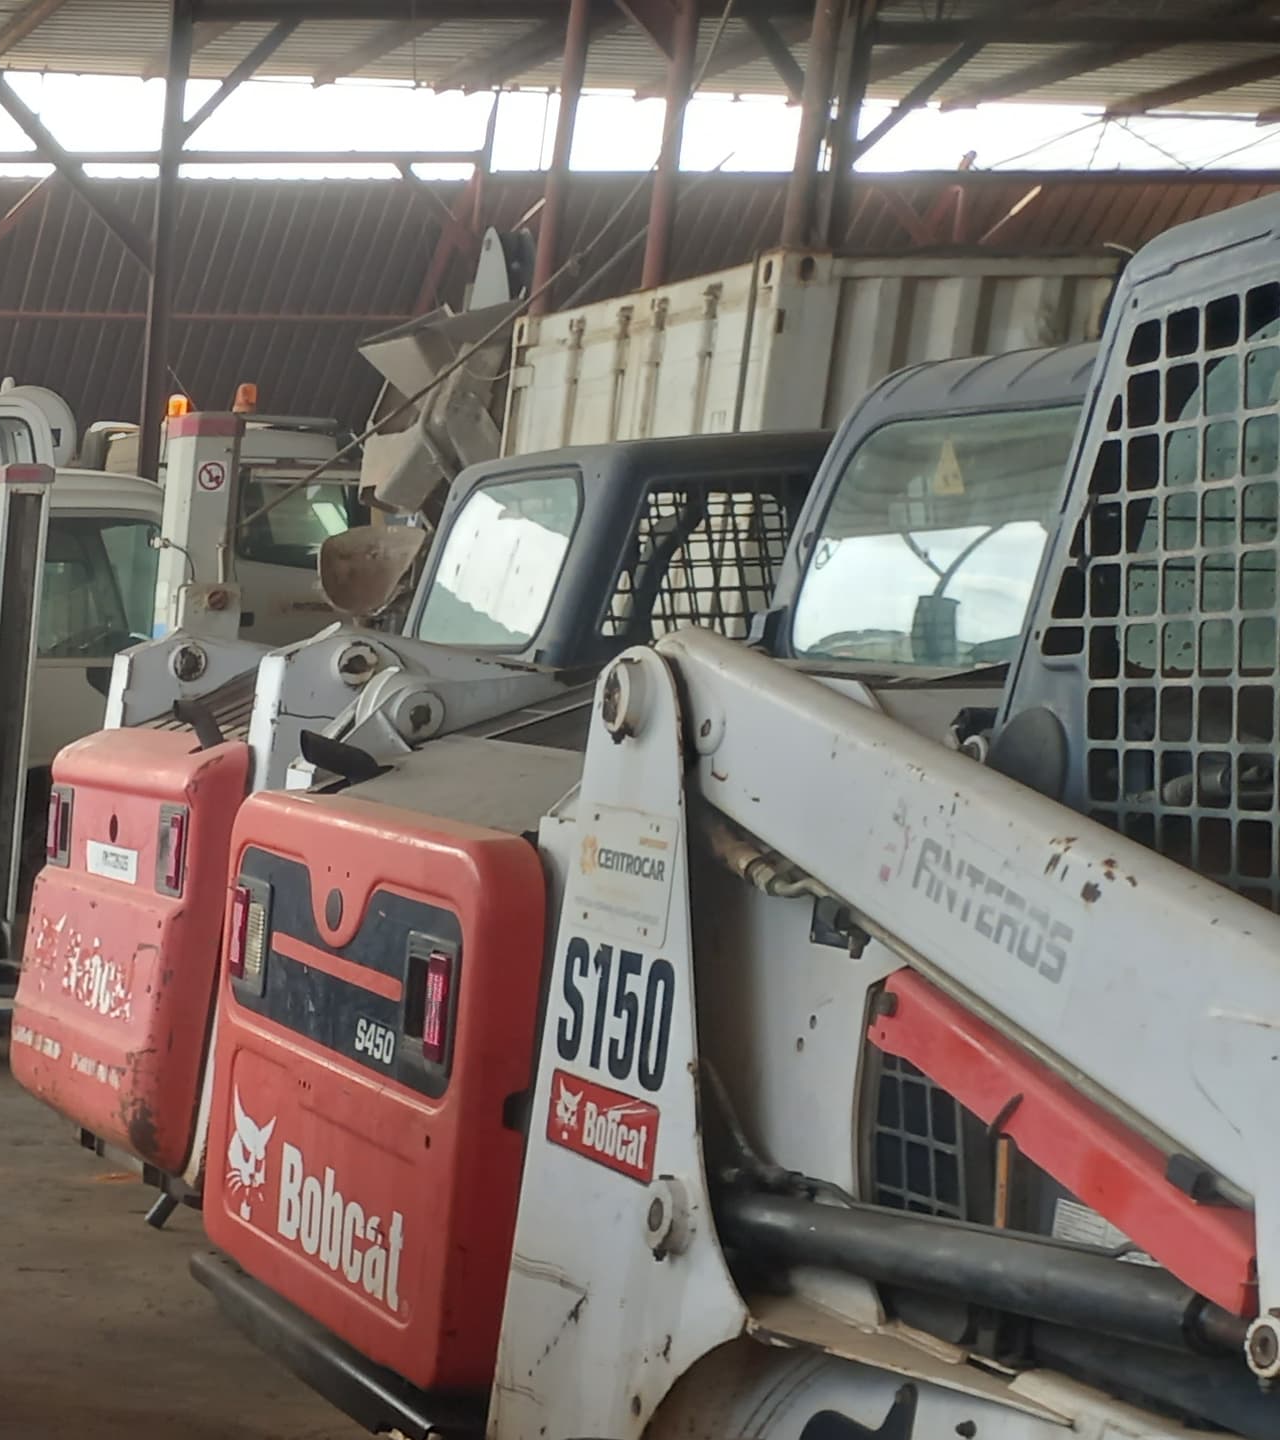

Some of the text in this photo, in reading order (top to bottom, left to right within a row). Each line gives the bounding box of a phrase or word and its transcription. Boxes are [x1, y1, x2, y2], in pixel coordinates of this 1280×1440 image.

[354, 1017, 397, 1066] S450
[556, 935, 676, 1093] S150
[581, 1101, 649, 1170] Bobcat
[277, 1141, 404, 1313] Bobcat
